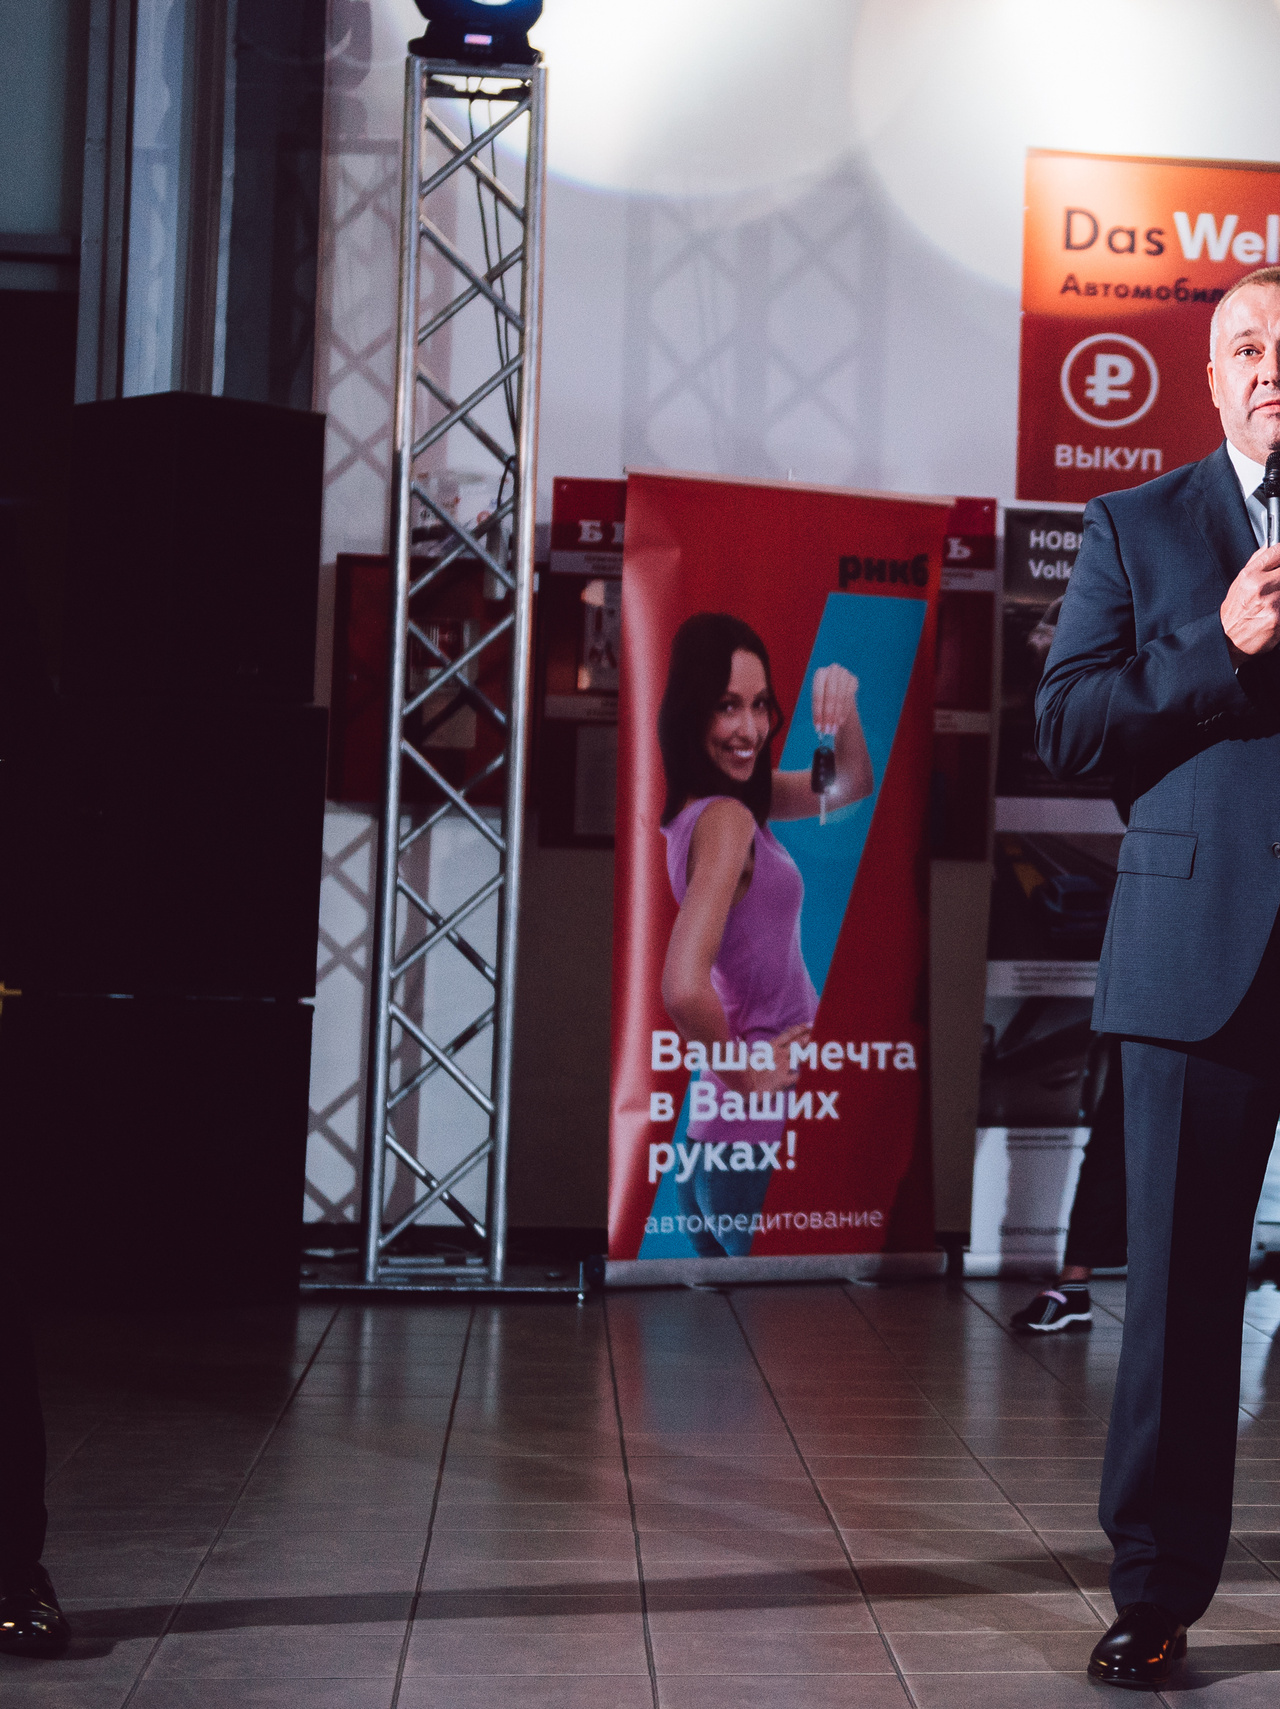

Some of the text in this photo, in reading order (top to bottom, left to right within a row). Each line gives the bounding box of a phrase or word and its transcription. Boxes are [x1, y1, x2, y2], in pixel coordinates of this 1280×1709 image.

[1060, 273, 1225, 303] Автомобил
[1054, 444, 1163, 472] ВЫКУП
[838, 554, 929, 588] рнкб
[1028, 558, 1073, 579] Volk
[651, 1030, 918, 1071] Ваша мечта
[649, 1080, 840, 1122] в Ваших
[648, 1130, 798, 1184] руках!
[644, 1210, 885, 1236] автокредитование
